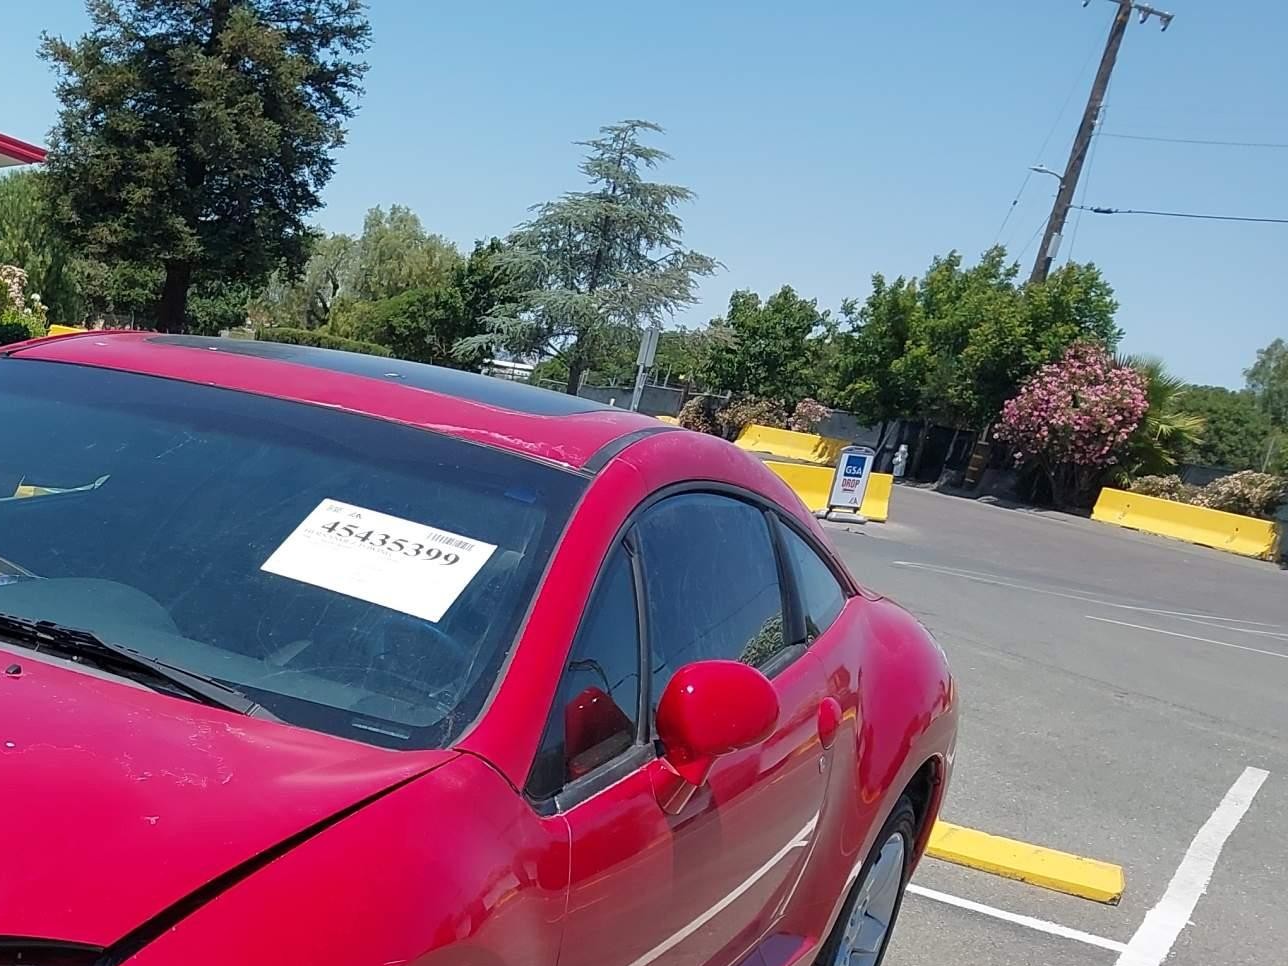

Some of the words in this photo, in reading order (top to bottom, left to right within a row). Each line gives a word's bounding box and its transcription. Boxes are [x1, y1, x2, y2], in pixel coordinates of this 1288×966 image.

[845, 465, 862, 475] GSA
[841, 478, 861, 489] DROP
[321, 521, 461, 566] 45435399
